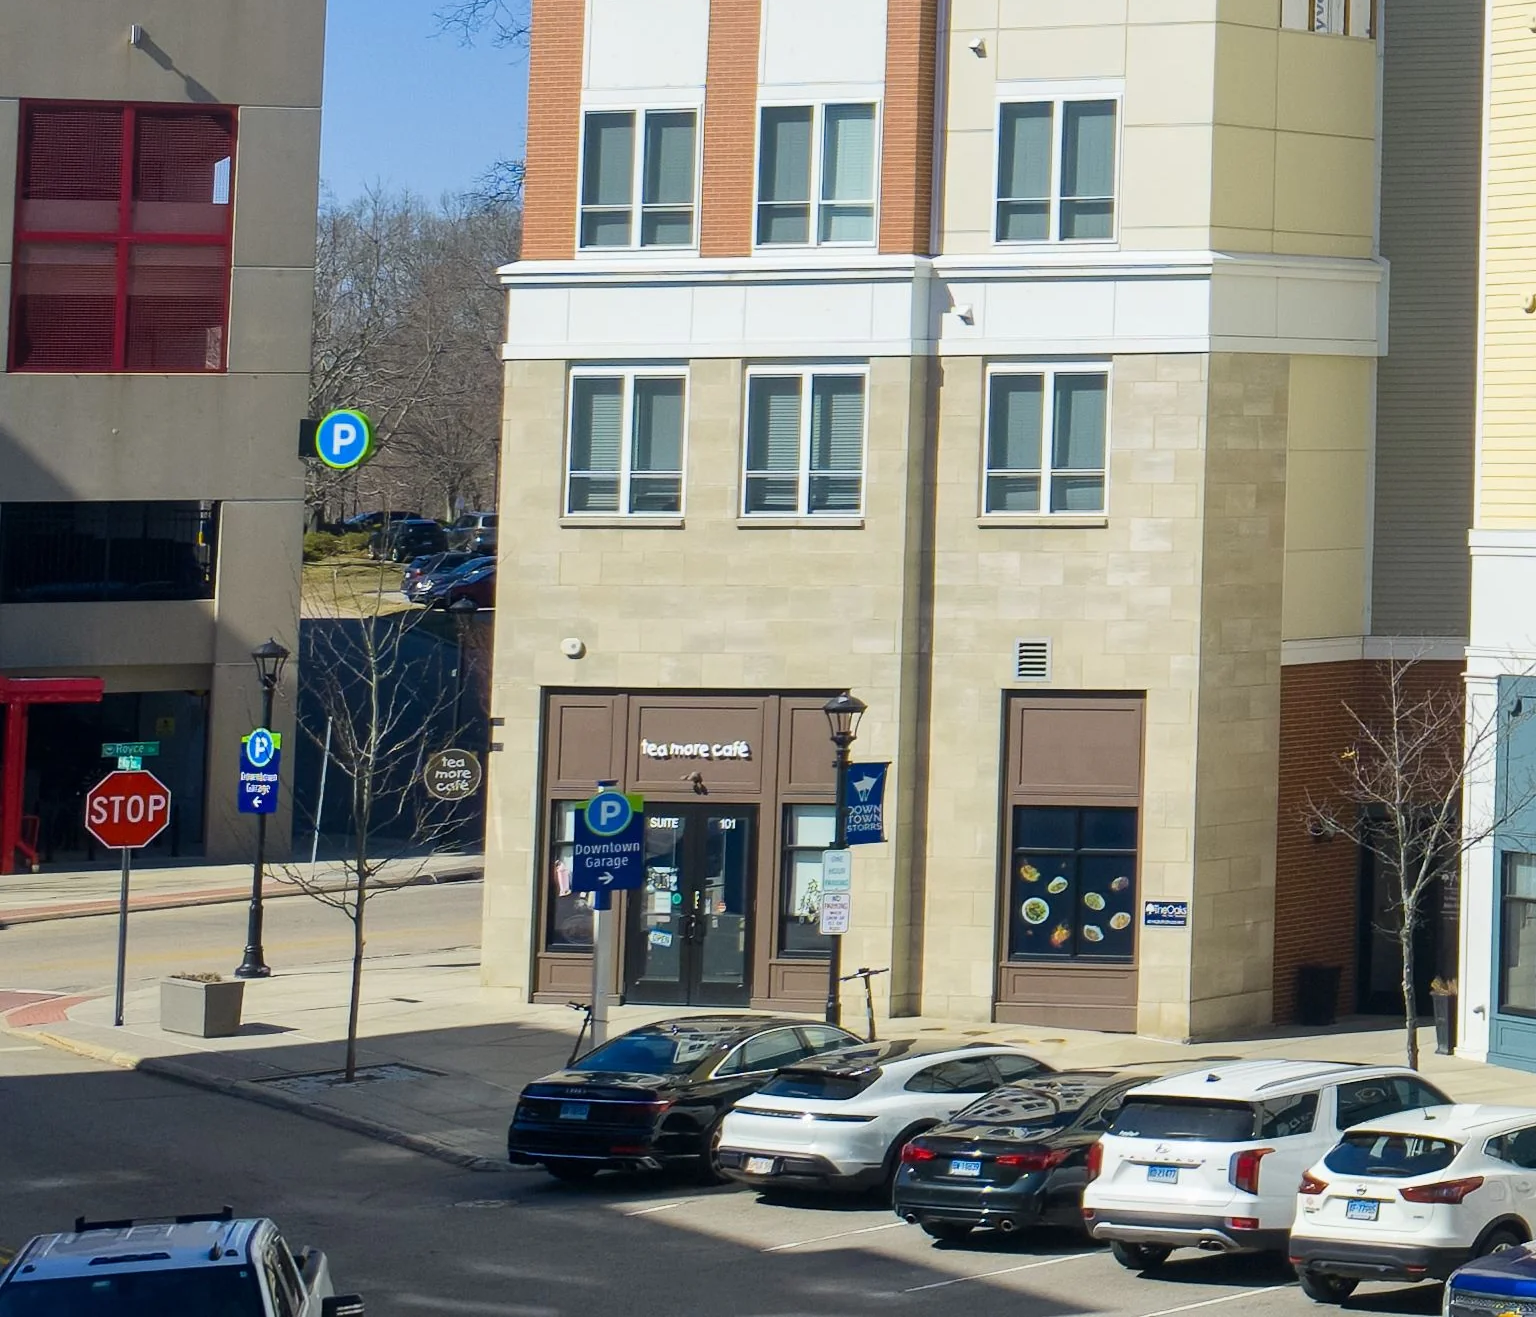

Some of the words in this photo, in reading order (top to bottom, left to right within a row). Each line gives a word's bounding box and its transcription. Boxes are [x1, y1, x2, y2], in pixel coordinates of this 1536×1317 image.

[332, 423, 357, 455] P
[116, 744, 144, 754] Royce
[254, 736, 268, 758] P
[641, 739, 667, 757] tea
[670, 742, 709, 757] more
[711, 741, 750, 757] café
[441, 756, 465, 767] tea
[434, 769, 471, 779] more
[436, 780, 470, 792] café
[90, 795, 166, 824] STOP
[600, 801, 621, 826] P
[650, 817, 679, 829] SUITE
[719, 819, 736, 829] 101
[848, 813, 882, 825] TOWN
[847, 823, 882, 833] STORRS
[575, 841, 640, 855] Downtown
[585, 856, 628, 868] Garage
